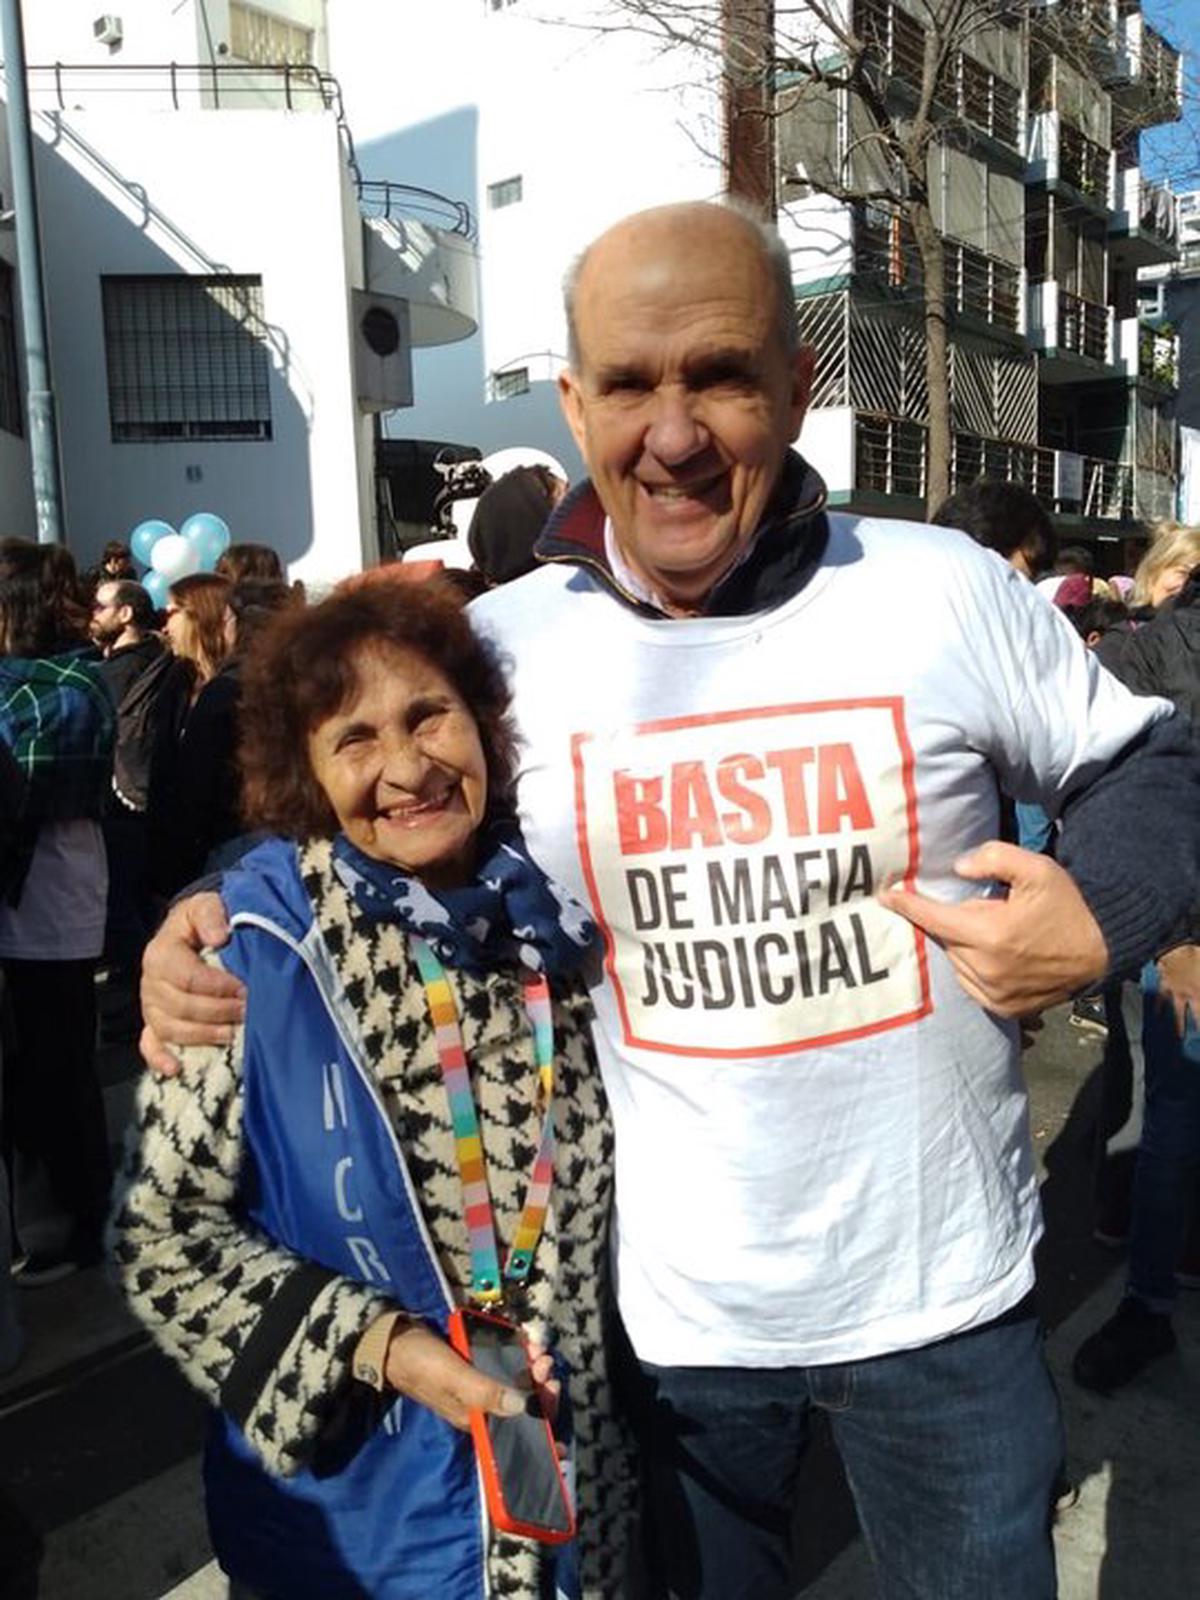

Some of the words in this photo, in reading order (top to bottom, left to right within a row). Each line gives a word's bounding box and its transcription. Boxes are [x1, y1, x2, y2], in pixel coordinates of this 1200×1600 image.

[612, 742, 875, 856] BASTA
[625, 864, 695, 932] DE
[706, 843, 874, 926] MAFIA
[641, 912, 890, 1010] JUDICIAL
